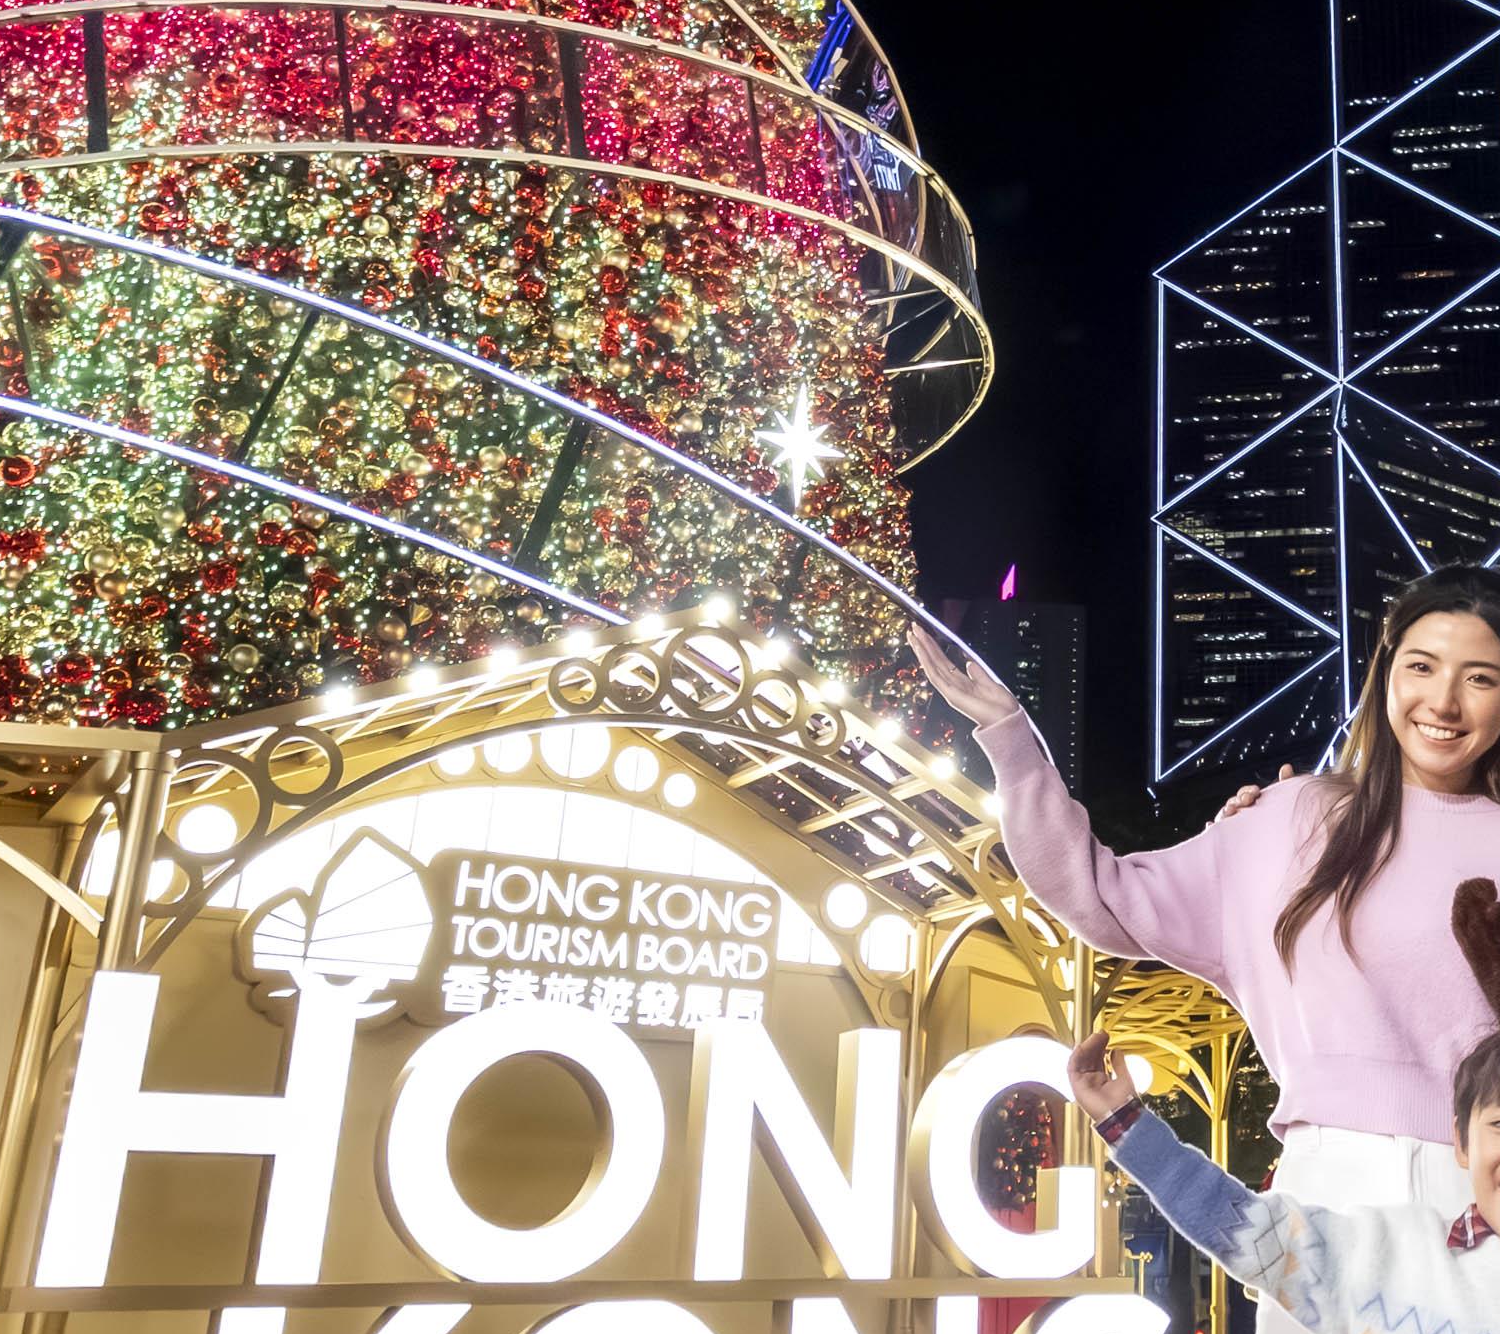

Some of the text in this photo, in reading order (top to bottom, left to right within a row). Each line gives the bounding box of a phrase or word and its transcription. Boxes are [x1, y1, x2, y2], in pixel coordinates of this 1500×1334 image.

[454, 861, 773, 937] HONG KONG
[451, 915, 768, 980] TOURISM BOARD
[32, 970, 1097, 1288] HONG
